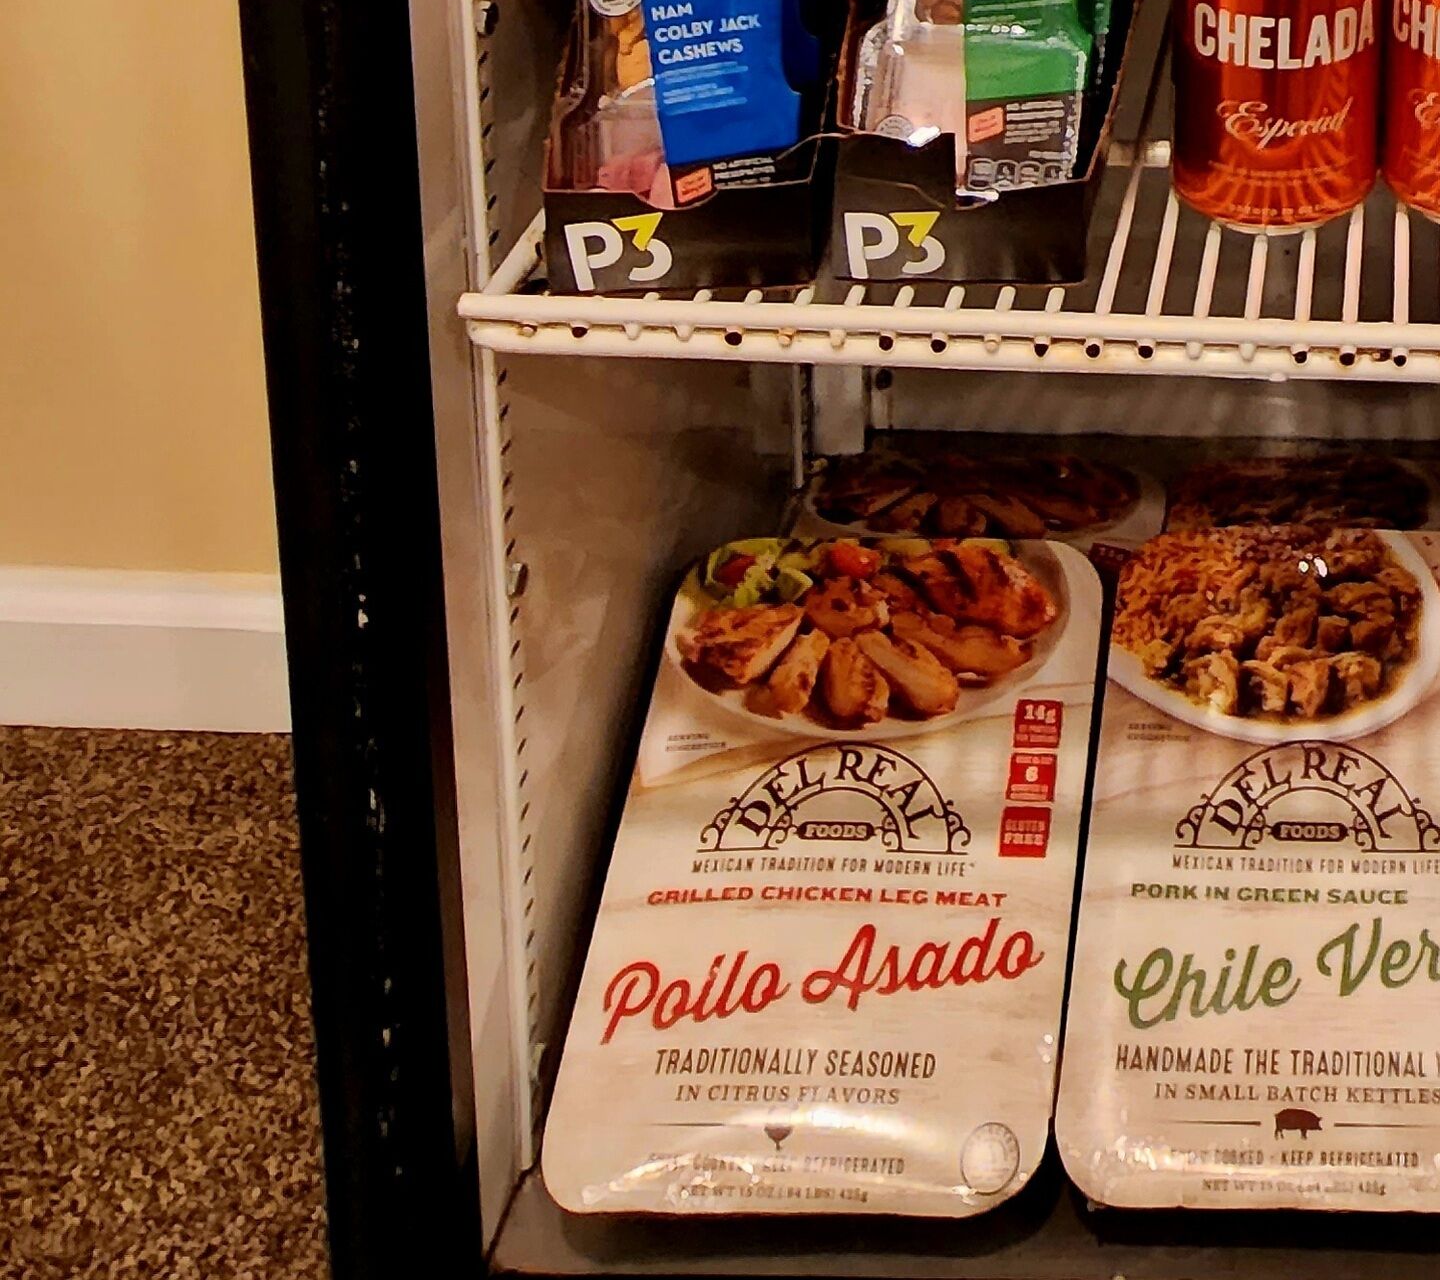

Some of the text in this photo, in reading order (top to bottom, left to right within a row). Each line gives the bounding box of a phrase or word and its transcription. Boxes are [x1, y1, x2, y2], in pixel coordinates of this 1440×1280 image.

[650, 1, 694, 22] HAM
[654, 13, 762, 43] COLBY JACK
[657, 37, 745, 65] CASHEWS
[1216, 95, 1354, 151] Especial
[563, 211, 674, 292] P3
[844, 211, 946, 280] P3
[735, 748, 943, 841] DEL REAL
[1209, 746, 1413, 839] DEL REAL
[802, 823, 868, 840] FOODS
[1279, 823, 1341, 839] FOODS
[691, 856, 932, 876] MEXICAN TRADITION FOR MODERN
[1172, 854, 1407, 874] MEXICAN TRADITION FOR MODERN
[646, 886, 1008, 909] GRILLED CHICKEN LEG MEAT
[1130, 882, 1410, 906] PORK IN GREEN SAUCE
[599, 916, 1046, 1046] Pollo Asado
[1113, 942, 1302, 1031] Chile
[653, 1046, 938, 1080] TRADITIONALLY SEASONED
[1114, 1043, 1235, 1075] HANDMADE
[1243, 1048, 1281, 1077] THE
[1290, 1049, 1427, 1079] TRADITIONAL
[675, 1084, 901, 1107] IN CITRUS FLAVORS
[1152, 1081, 1179, 1101] IN
[1184, 1083, 1260, 1102] SMALL
[1266, 1084, 1339, 1104] BATCH
[1279, 1150, 1421, 1168] KEEP REFRIGERATED
